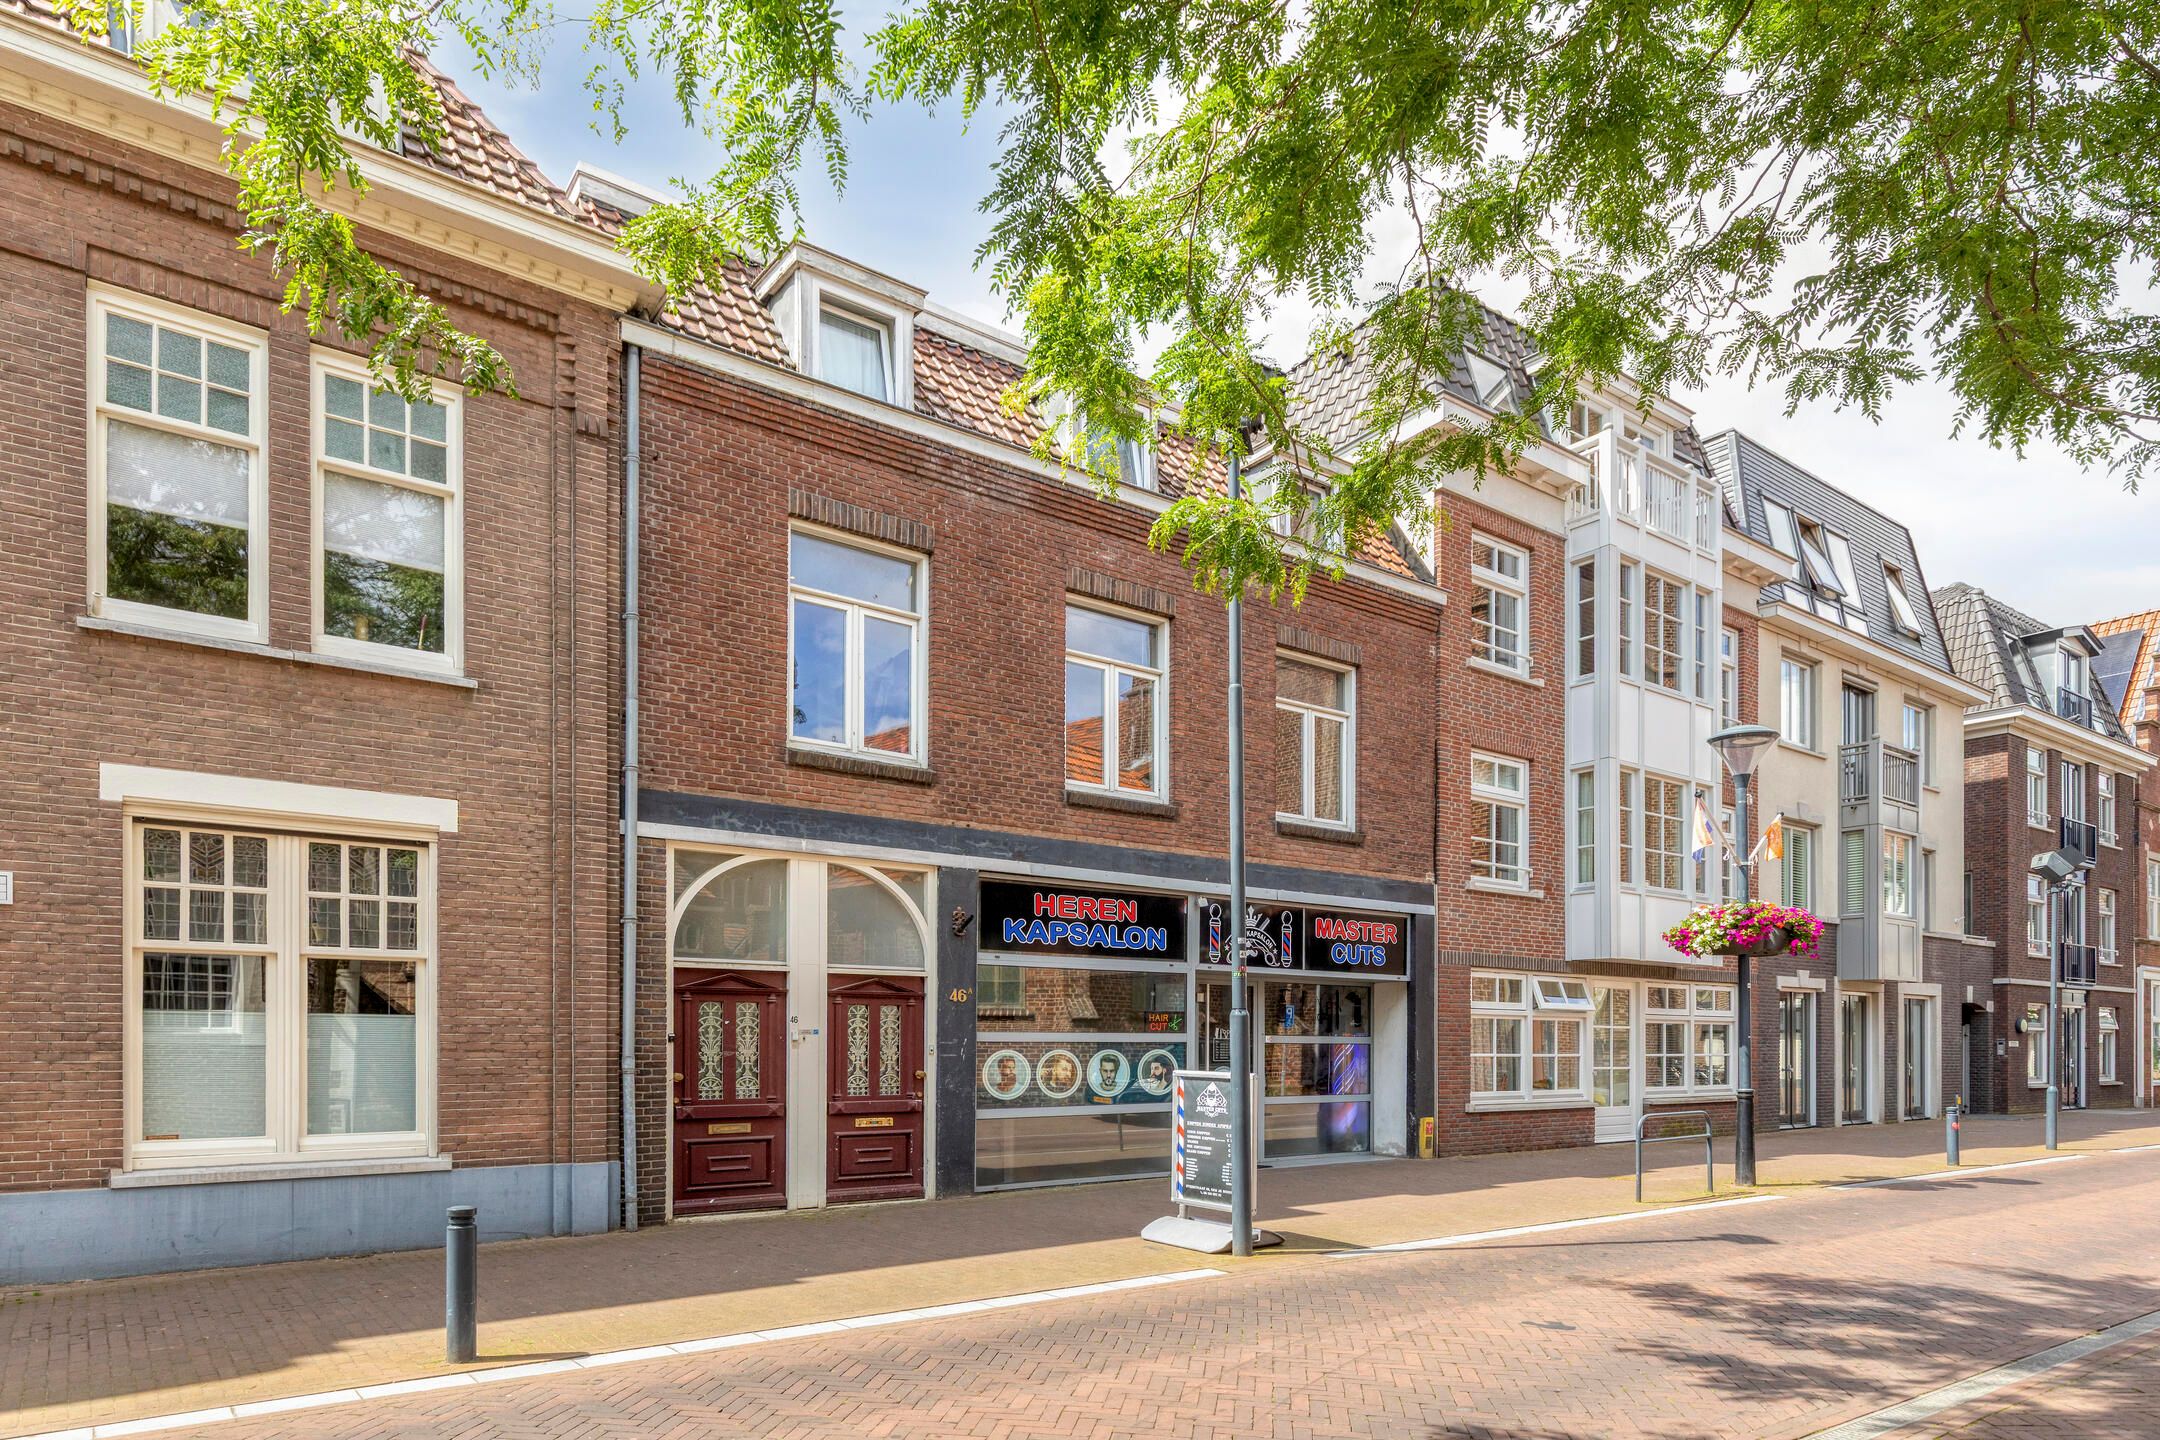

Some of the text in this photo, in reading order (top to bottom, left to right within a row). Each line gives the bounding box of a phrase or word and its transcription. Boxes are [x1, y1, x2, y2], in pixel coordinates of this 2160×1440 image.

[1034, 893, 1137, 923] HEREN
[1003, 918, 1167, 951] KAPSALON
[1246, 930, 1274, 949] KAPSALON
[1315, 917, 1397, 944] MASTER
[1331, 942, 1386, 966] CUTS
[790, 1016, 799, 1024] 46
[1150, 1022, 1168, 1031] CUT
